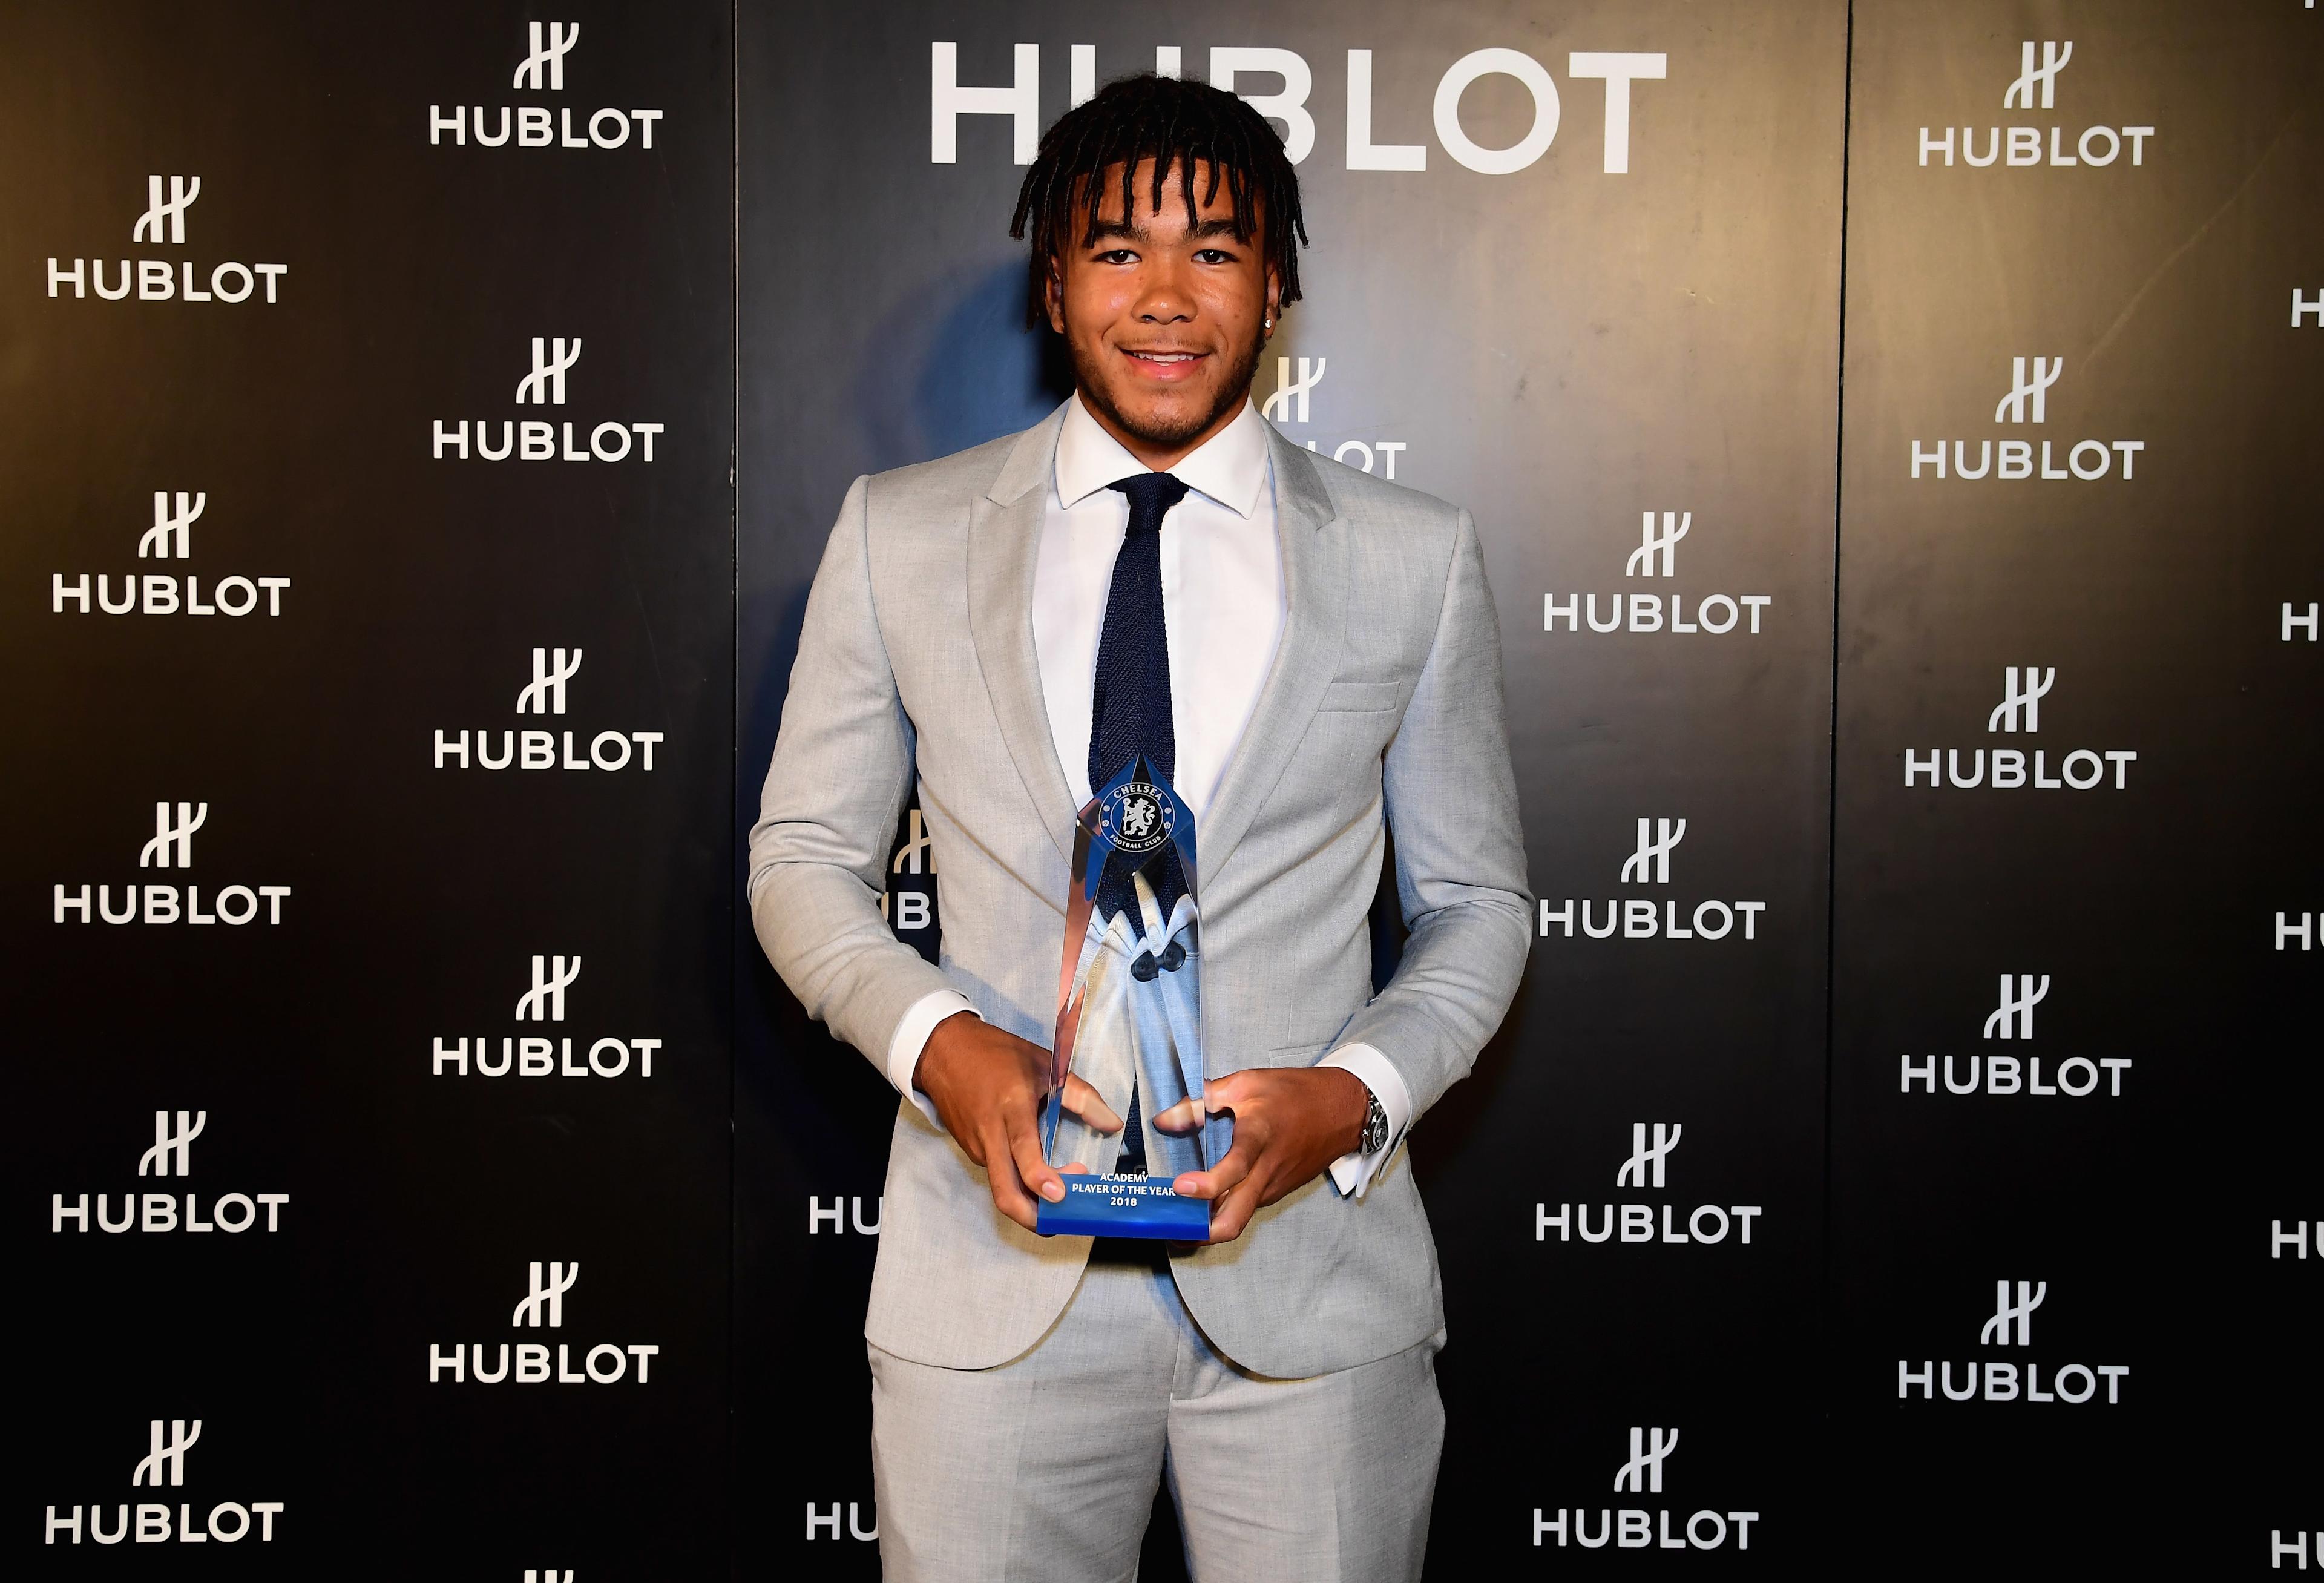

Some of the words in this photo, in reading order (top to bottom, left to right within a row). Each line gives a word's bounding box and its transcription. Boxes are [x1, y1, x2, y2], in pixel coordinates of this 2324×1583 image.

[430, 105, 663, 149] HUBLOT
[1919, 126, 2154, 166] HUBLOT
[48, 258, 287, 303] HUBLOT
[434, 420, 664, 462] HUBLOT
[1911, 440, 2144, 480] HUBLOT
[53, 574, 290, 616] HUBLOT
[1544, 594, 1771, 633] HUBLOT
[435, 730, 663, 771] HUBLOT
[1906, 749, 2136, 789] HUBLOT
[1114, 785, 1162, 800] CHELSEA
[1110, 834, 1141, 849] FOOTBALL
[1144, 835, 1161, 847] CLUB
[54, 885, 290, 925] HUBLOT
[1540, 900, 1765, 939] HUBLOT
[2276, 912, 2324, 950] H
[433, 1038, 661, 1077] HUBLOT
[1902, 1055, 2132, 1096] HUBLOT
[1072, 1184, 1109, 1194] PLAYER
[1111, 1185, 1125, 1194] OF
[1127, 1186, 1147, 1195] THE
[1149, 1186, 1176, 1196] YEAR
[1100, 1173, 1149, 1183] ACADEMY
[53, 1193, 289, 1233] HUBLOT
[1111, 1197, 1137, 1206] 2018
[1537, 1203, 1761, 1244] HUBLOT
[2272, 1220, 2324, 1259] H
[430, 1344, 658, 1383] HUBLOT
[1899, 1361, 2129, 1403] HUBLOT
[46, 1502, 284, 1544] HUBLOT
[1534, 1509, 1759, 1549] HUBLOT
[2272, 1530, 2324, 1569] H
